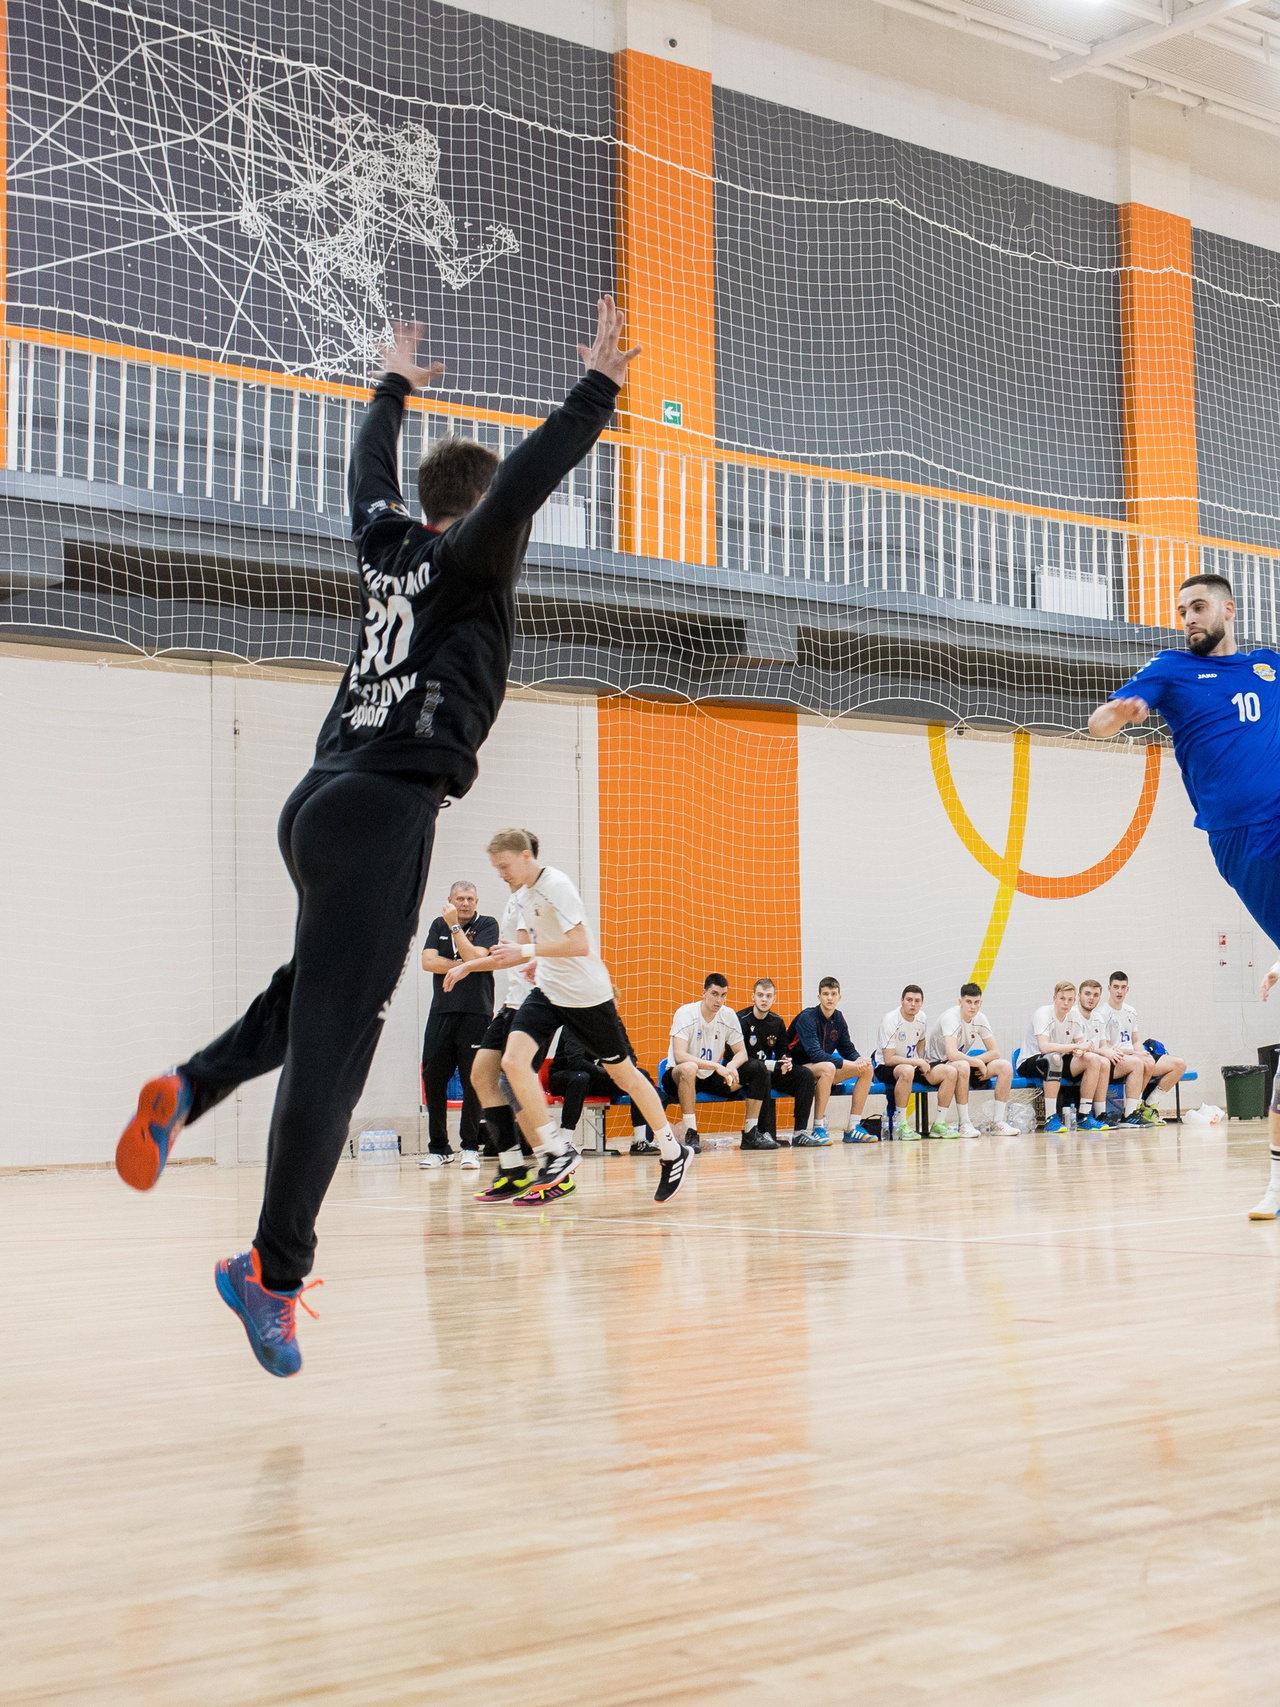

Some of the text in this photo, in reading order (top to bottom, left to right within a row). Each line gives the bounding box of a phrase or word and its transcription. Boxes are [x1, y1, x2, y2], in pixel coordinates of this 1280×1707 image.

[360, 594, 414, 677] 30
[1231, 692, 1261, 722] 10
[700, 1047, 713, 1061] 20
